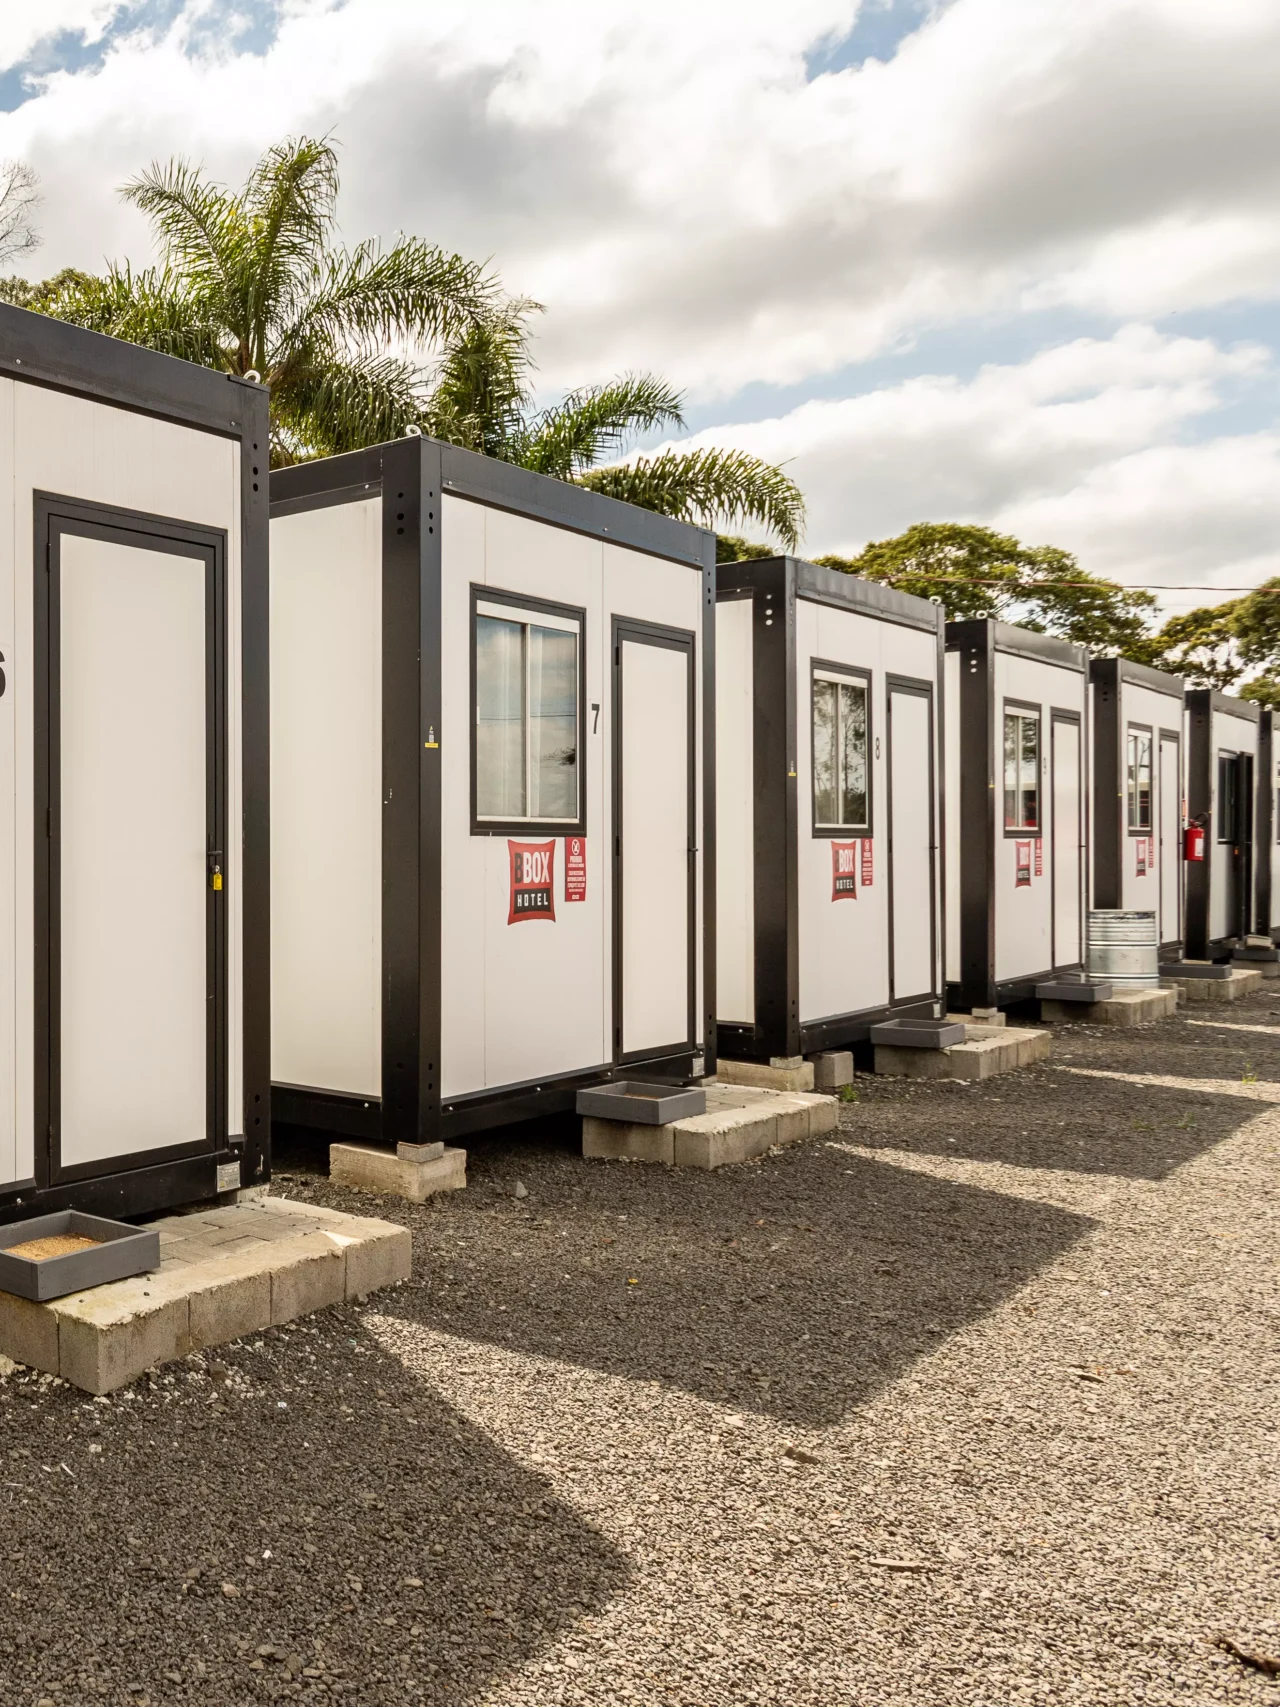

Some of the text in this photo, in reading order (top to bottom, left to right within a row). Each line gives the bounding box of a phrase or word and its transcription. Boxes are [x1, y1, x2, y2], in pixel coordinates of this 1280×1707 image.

[592, 704, 600, 734] 7
[876, 736, 880, 760] 8
[514, 852, 550, 884] BBOX
[518, 893, 548, 907] HOTEL
